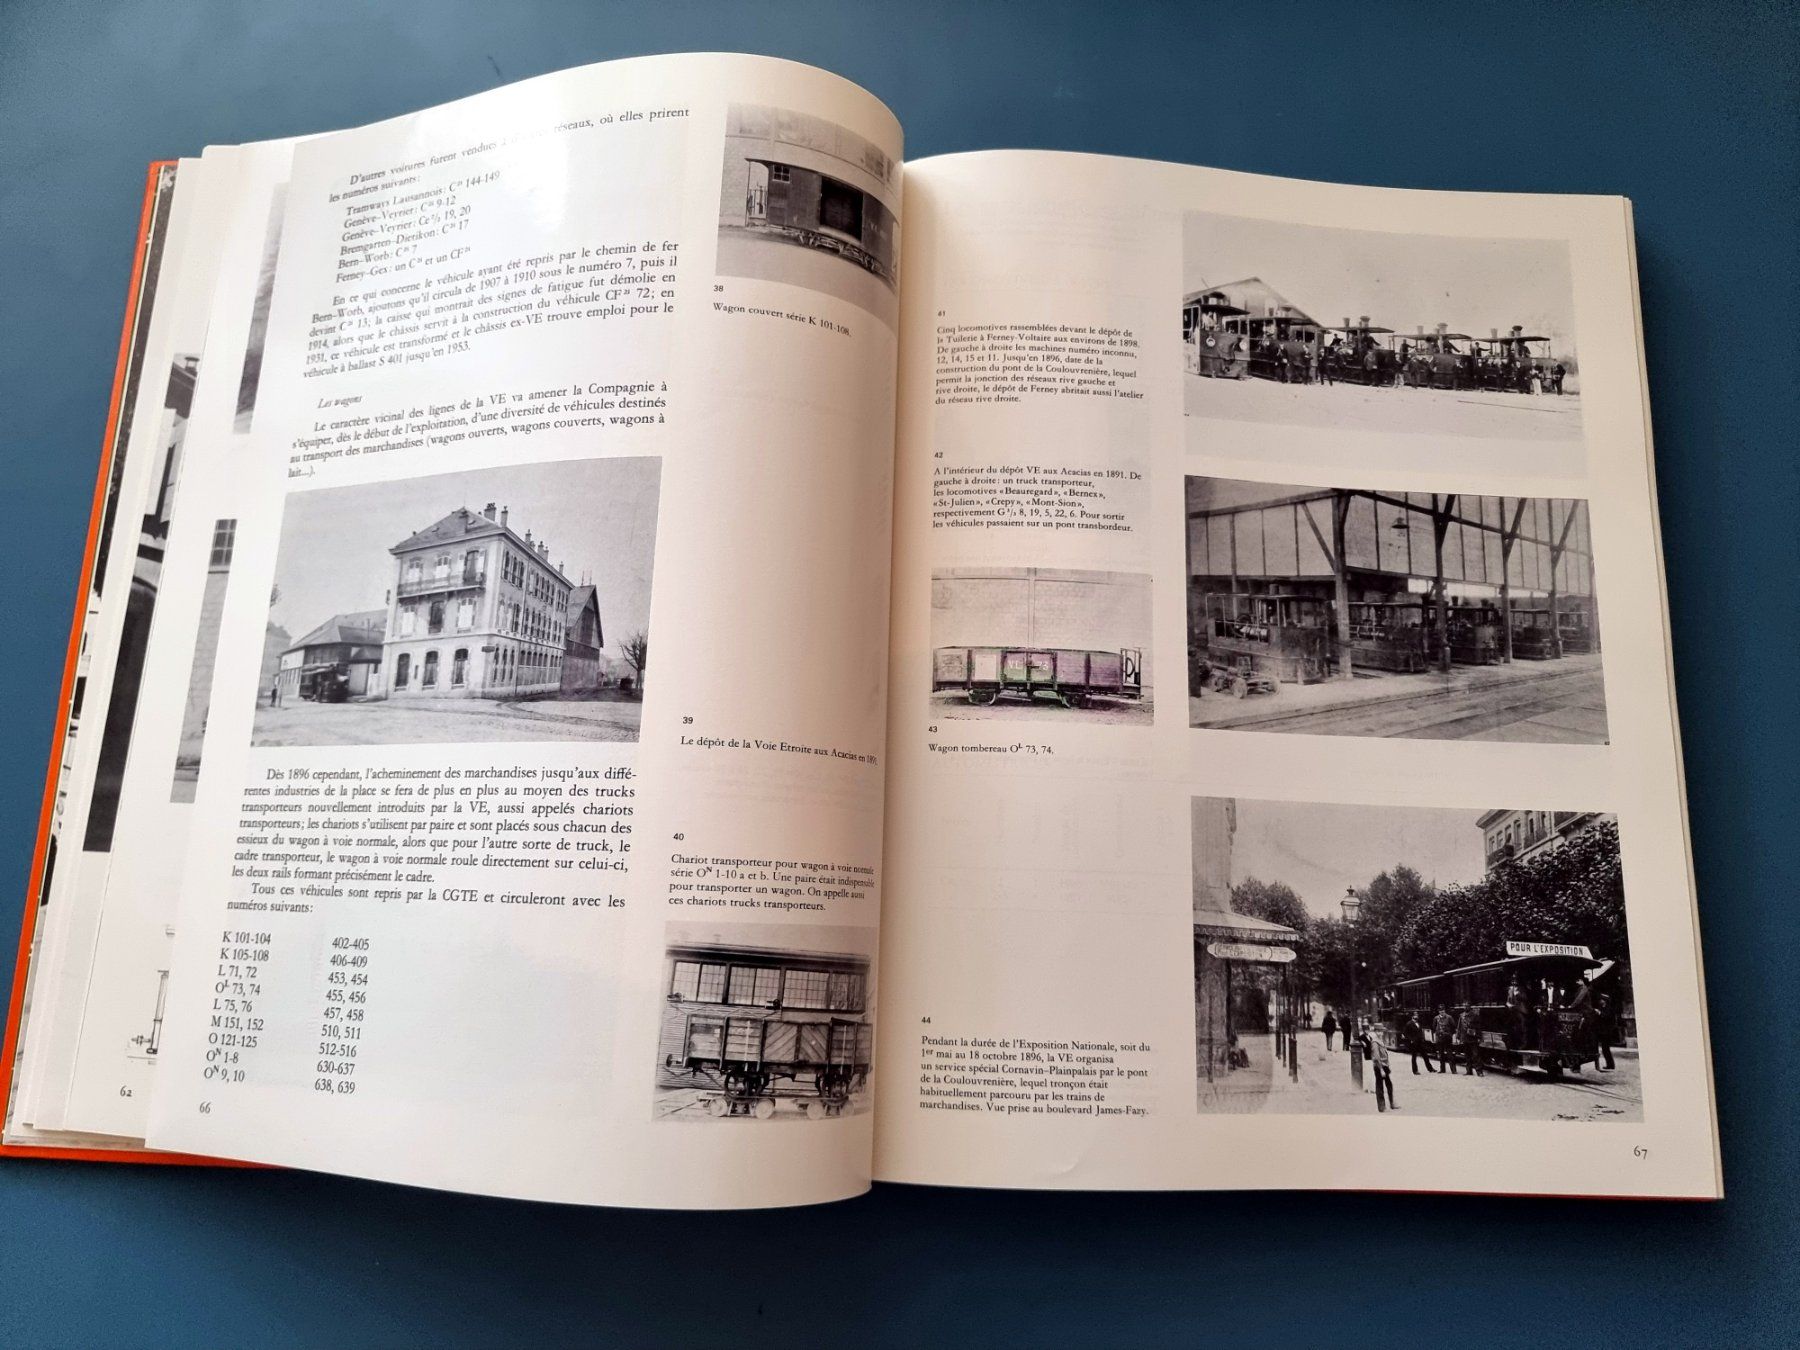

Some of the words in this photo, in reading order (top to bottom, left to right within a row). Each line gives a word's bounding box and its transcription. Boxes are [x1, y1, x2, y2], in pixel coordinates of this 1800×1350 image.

[599, 113, 613, 124] où
[619, 110, 643, 121] elles
[649, 108, 689, 122] prirent
[595, 243, 636, 256] chemin
[642, 241, 656, 252] de
[662, 240, 679, 251] fer
[578, 260, 622, 273] numéro
[625, 257, 636, 270] 7,
[640, 256, 665, 271] puis
[669, 255, 677, 267] il
[589, 276, 605, 287] fut
[610, 272, 656, 285] démolie
[661, 274, 676, 282] en
[713, 284, 724, 292] 38
[547, 311, 582, 321] trouve
[586, 305, 625, 319] emploi
[629, 305, 659, 317] pour
[663, 302, 674, 313] le
[713, 302, 745, 313] Wagon
[748, 308, 783, 318] couvert
[786, 312, 806, 322] série
[808, 316, 816, 325] K
[820, 319, 851, 336] 101-108.
[936, 326, 956, 335] Cinq
[1009, 323, 1057, 331] rassemblées
[1059, 324, 1087, 333] devant
[1089, 326, 1096, 334] le
[1098, 327, 1121, 337] dépôt
[1122, 329, 1133, 337] de
[313, 422, 326, 432] Le
[329, 416, 370, 429] caractère
[374, 409, 405, 423] vicinal
[408, 407, 424, 418] des
[428, 404, 455, 417] lignes
[459, 399, 471, 410] de
[475, 397, 484, 408] la
[489, 393, 506, 404] VE
[511, 394, 523, 402] va
[528, 389, 567, 400] amener
[572, 384, 582, 395] la
[588, 381, 655, 395] Compagnie
[660, 381, 667, 391] à
[934, 467, 941, 475] A
[943, 466, 984, 474] l'intérieur
[986, 465, 997, 473] du
[999, 465, 1023, 475] dépôt
[1026, 465, 1040, 474] VE
[1060, 467, 1091, 476] Acacias
[1106, 470, 1127, 479] 1891.
[1129, 471, 1142, 480] De
[682, 716, 694, 724] 39
[928, 725, 938, 733] 43
[680, 735, 694, 745] Le
[696, 736, 725, 749] dépôt
[727, 738, 739, 747] de
[742, 739, 751, 748] la
[754, 739, 777, 750] Voie
[780, 742, 812, 753] Etroite
[813, 748, 828, 756] aux
[830, 748, 857, 760] Acacias
[928, 743, 958, 753] Wagon
[961, 744, 1007, 753] tombereau
[1025, 744, 1038, 755] 73,
[1041, 745, 1054, 754] 74.
[266, 768, 284, 780] Dès
[288, 768, 310, 780] 1896
[312, 768, 363, 783] cependant,
[364, 767, 441, 779] l'acheminement
[444, 766, 461, 778] des
[464, 766, 537, 778] marchandises
[541, 767, 599, 783] jusqu'aux
[604, 767, 636, 779] diffé-
[673, 833, 684, 841] 40
[251, 882, 275, 894] Tous
[279, 886, 294, 895] ces
[300, 884, 343, 897] véhicules
[347, 888, 369, 898] sont
[373, 887, 401, 902] repris
[405, 891, 423, 903] par
[427, 888, 437, 900] la
[442, 888, 478, 902] CGTE
[483, 893, 494, 903] et
[500, 892, 565, 905] circuleront
[572, 897, 601, 906] avec
[607, 895, 625, 907] les
[669, 883, 694, 893] pour
[696, 884, 752, 895] transporter
[771, 887, 804, 897] wagon.
[807, 886, 821, 896] On
[823, 888, 849, 900] appelle
[226, 900, 267, 911] numéros
[269, 903, 313, 913] suivants:
[668, 897, 683, 905] ces
[686, 895, 726, 906] chariots
[730, 898, 761, 907] trucks
[763, 901, 826, 911] transporteurs.
[222, 930, 232, 943] K
[235, 931, 271, 944] 101-104
[331, 937, 369, 950] 402-405
[219, 947, 229, 959] K
[232, 948, 269, 961] 105-108
[1510, 942, 1531, 951] POUR
[1533, 945, 1583, 955] L'EXPOSITION
[329, 954, 368, 967] 406-409
[217, 964, 226, 976] L
[228, 964, 242, 979] 71,
[245, 965, 257, 978] 72
[325, 989, 345, 1004] 455,
[348, 991, 366, 1004] 456
[212, 998, 221, 1010] L
[224, 998, 238, 1013] 75,
[241, 1000, 252, 1012] 76
[210, 1015, 222, 1027] M
[224, 1016, 243, 1031] 151,
[247, 1018, 264, 1031] 152
[921, 1016, 931, 1024] 44
[321, 1024, 341, 1040] 510,
[344, 1026, 361, 1040] 511
[208, 1032, 218, 1044] O
[220, 1033, 257, 1048] 121-125
[921, 1035, 957, 1046] Pendant
[960, 1037, 968, 1046] la
[970, 1037, 997, 1047] durée
[999, 1038, 1010, 1048] de
[1012, 1039, 1069, 1051] l'Exposition
[1071, 1040, 1118, 1052] Nationale,
[1120, 1043, 1136, 1051] soit
[1138, 1042, 1151, 1052] du
[318, 1042, 356, 1057] 512-516
[316, 1060, 355, 1075] 630-637
[119, 1085, 132, 1097] 62
[314, 1078, 334, 1094] 638,
[337, 1080, 355, 1094] 639
[199, 1101, 211, 1114] 66
[919, 1100, 983, 1111] marchandises.
[986, 1102, 1005, 1112] Vue
[1007, 1105, 1030, 1115] prise
[1046, 1104, 1092, 1114] boulevard
[1095, 1105, 1149, 1117] James-Fazy.
[1633, 1145, 1647, 1159] 67
